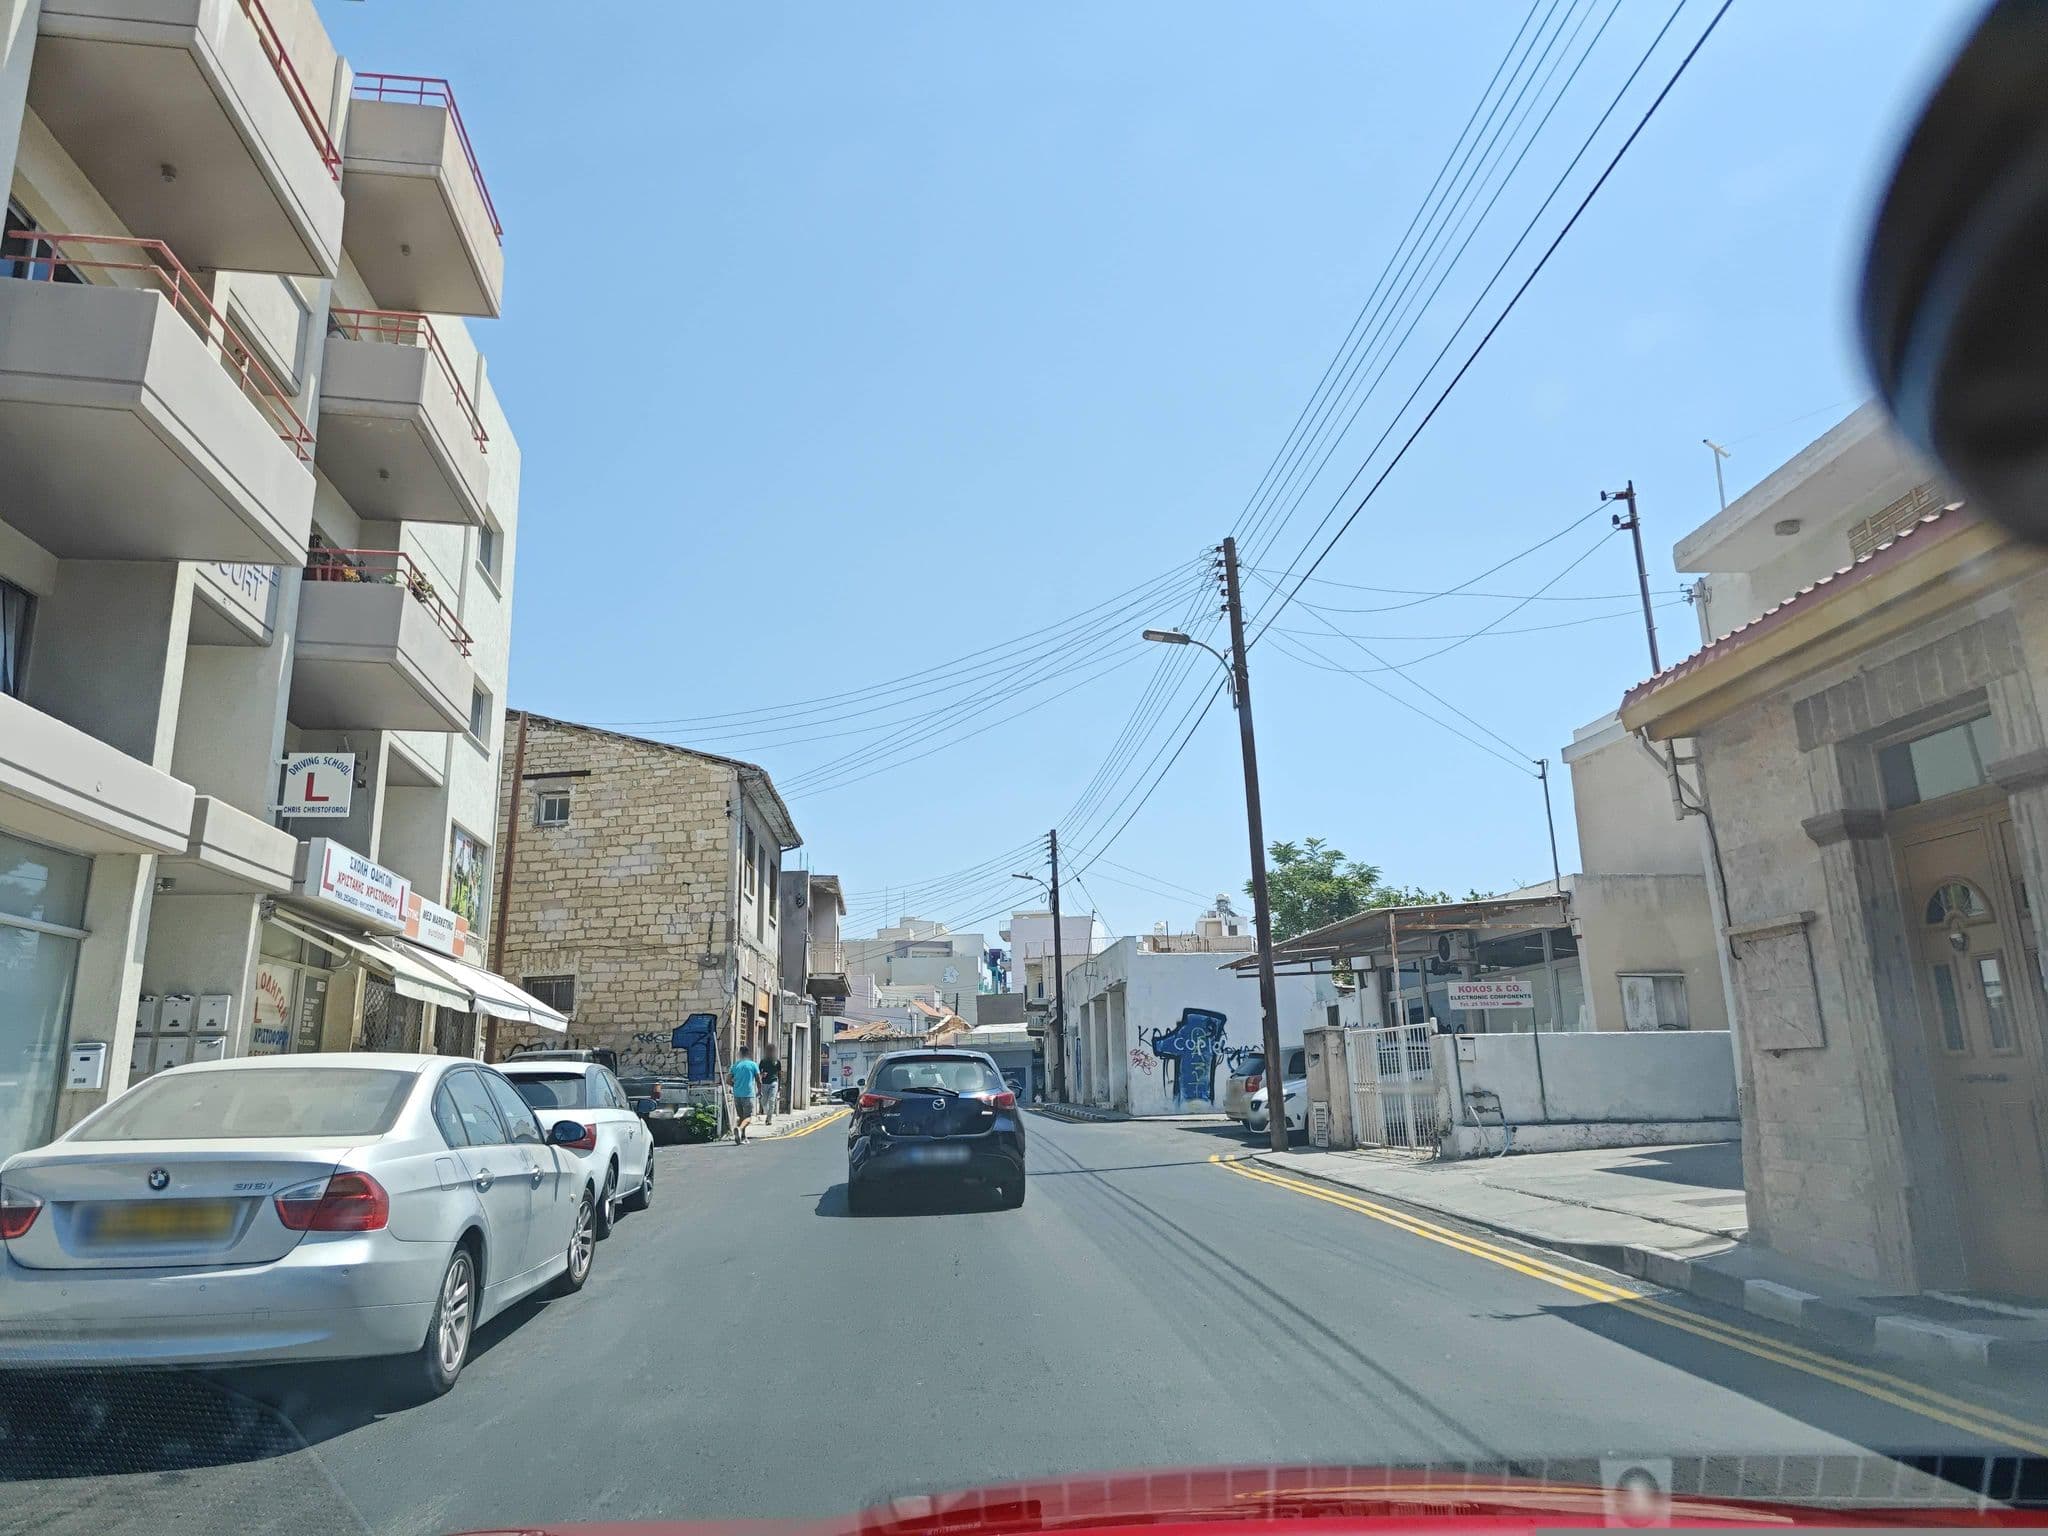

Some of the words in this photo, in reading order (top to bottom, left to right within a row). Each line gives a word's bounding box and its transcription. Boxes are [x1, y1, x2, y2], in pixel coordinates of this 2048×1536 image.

[288, 755, 320, 776] DRIVING
[323, 756, 352, 776] SCHOOL
[304, 772, 330, 802] L
[283, 806, 301, 814] CHRIS
[303, 806, 348, 814] CHRISTOFOROU
[322, 848, 335, 892] L
[349, 856, 369, 877] ΣΧΟΛΗ
[370, 867, 393, 889] ΟΔΗΓΩΝ
[398, 885, 407, 922] L
[432, 914, 454, 931] MARKETING
[1458, 985, 1493, 993] KOKOS
[1495, 985, 1503, 993] &
[1505, 984, 1522, 992] CO.
